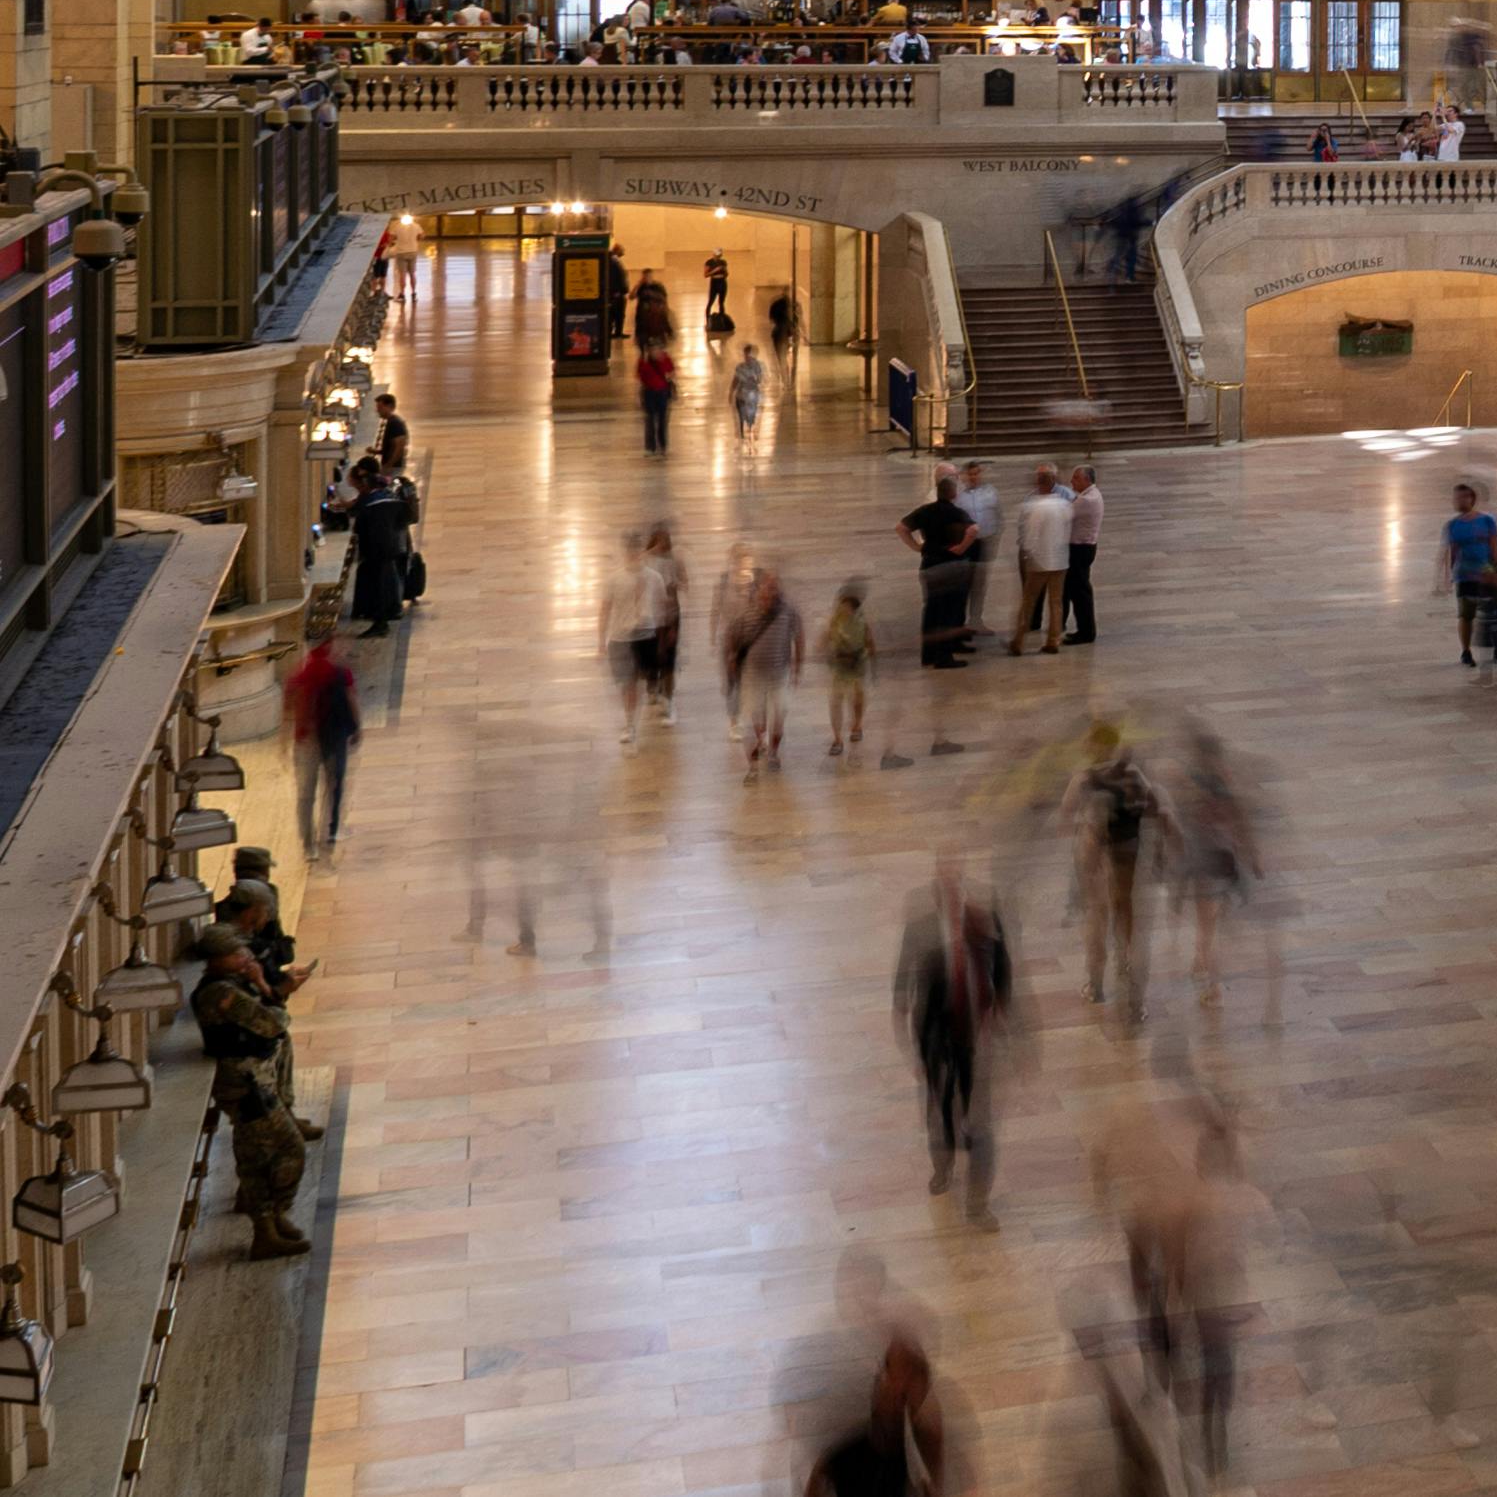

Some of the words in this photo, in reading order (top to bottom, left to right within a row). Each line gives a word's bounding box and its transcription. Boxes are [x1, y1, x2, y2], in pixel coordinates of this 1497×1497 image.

[962, 159, 1004, 172] WEST
[1009, 159, 1079, 172] BALCONY
[417, 178, 545, 204] MACHINES
[624, 178, 717, 198] SUBWAY
[733, 186, 790, 208] 42ND
[795, 195, 825, 213] ST
[1254, 272, 1305, 298] DINING
[1307, 256, 1384, 280] CONCOURSE
